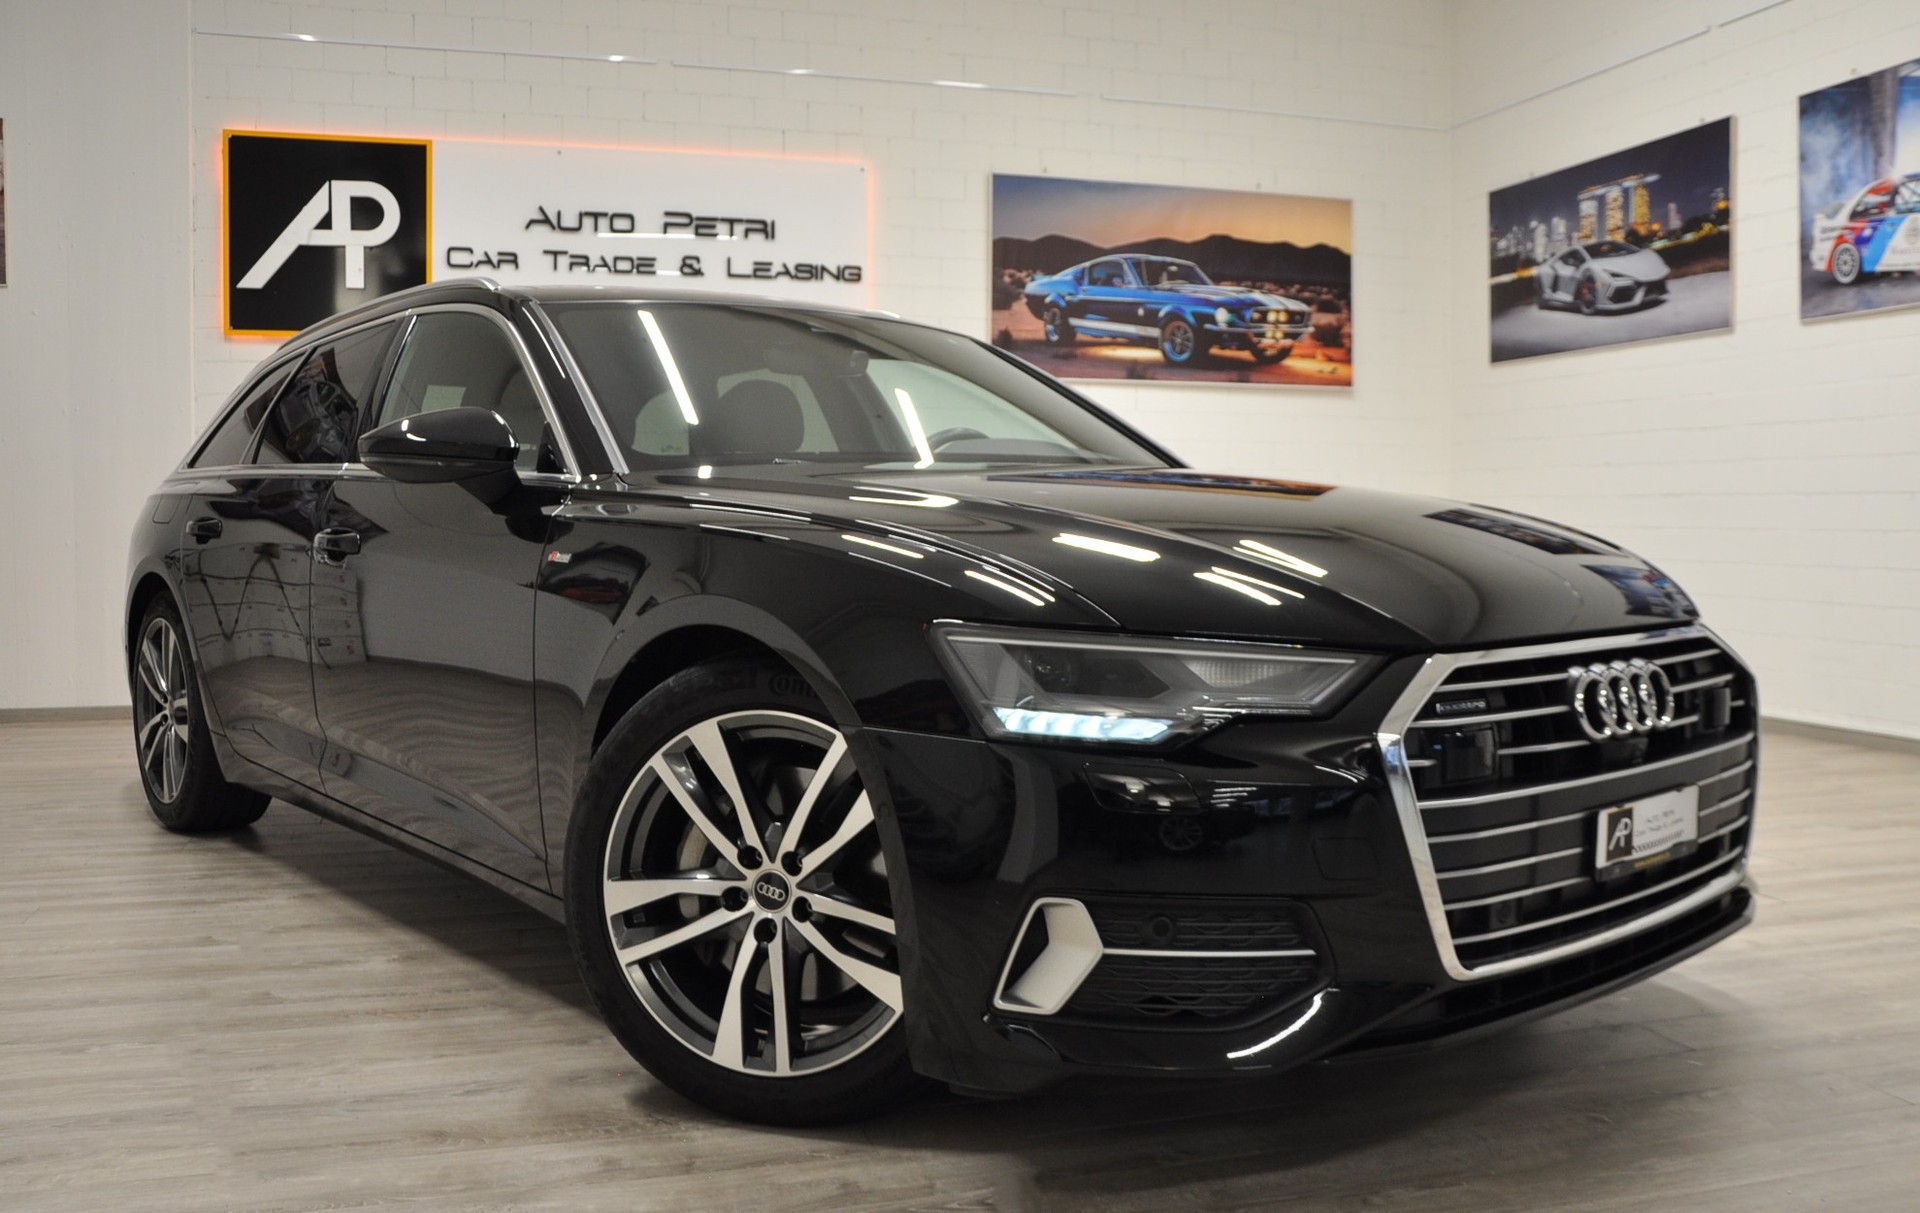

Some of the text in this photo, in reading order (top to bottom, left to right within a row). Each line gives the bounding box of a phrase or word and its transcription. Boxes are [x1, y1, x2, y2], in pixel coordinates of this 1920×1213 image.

[236, 179, 401, 289] AP
[525, 205, 776, 240] AUTO PETRI
[446, 246, 862, 283] CAR TRADE & LEASING
